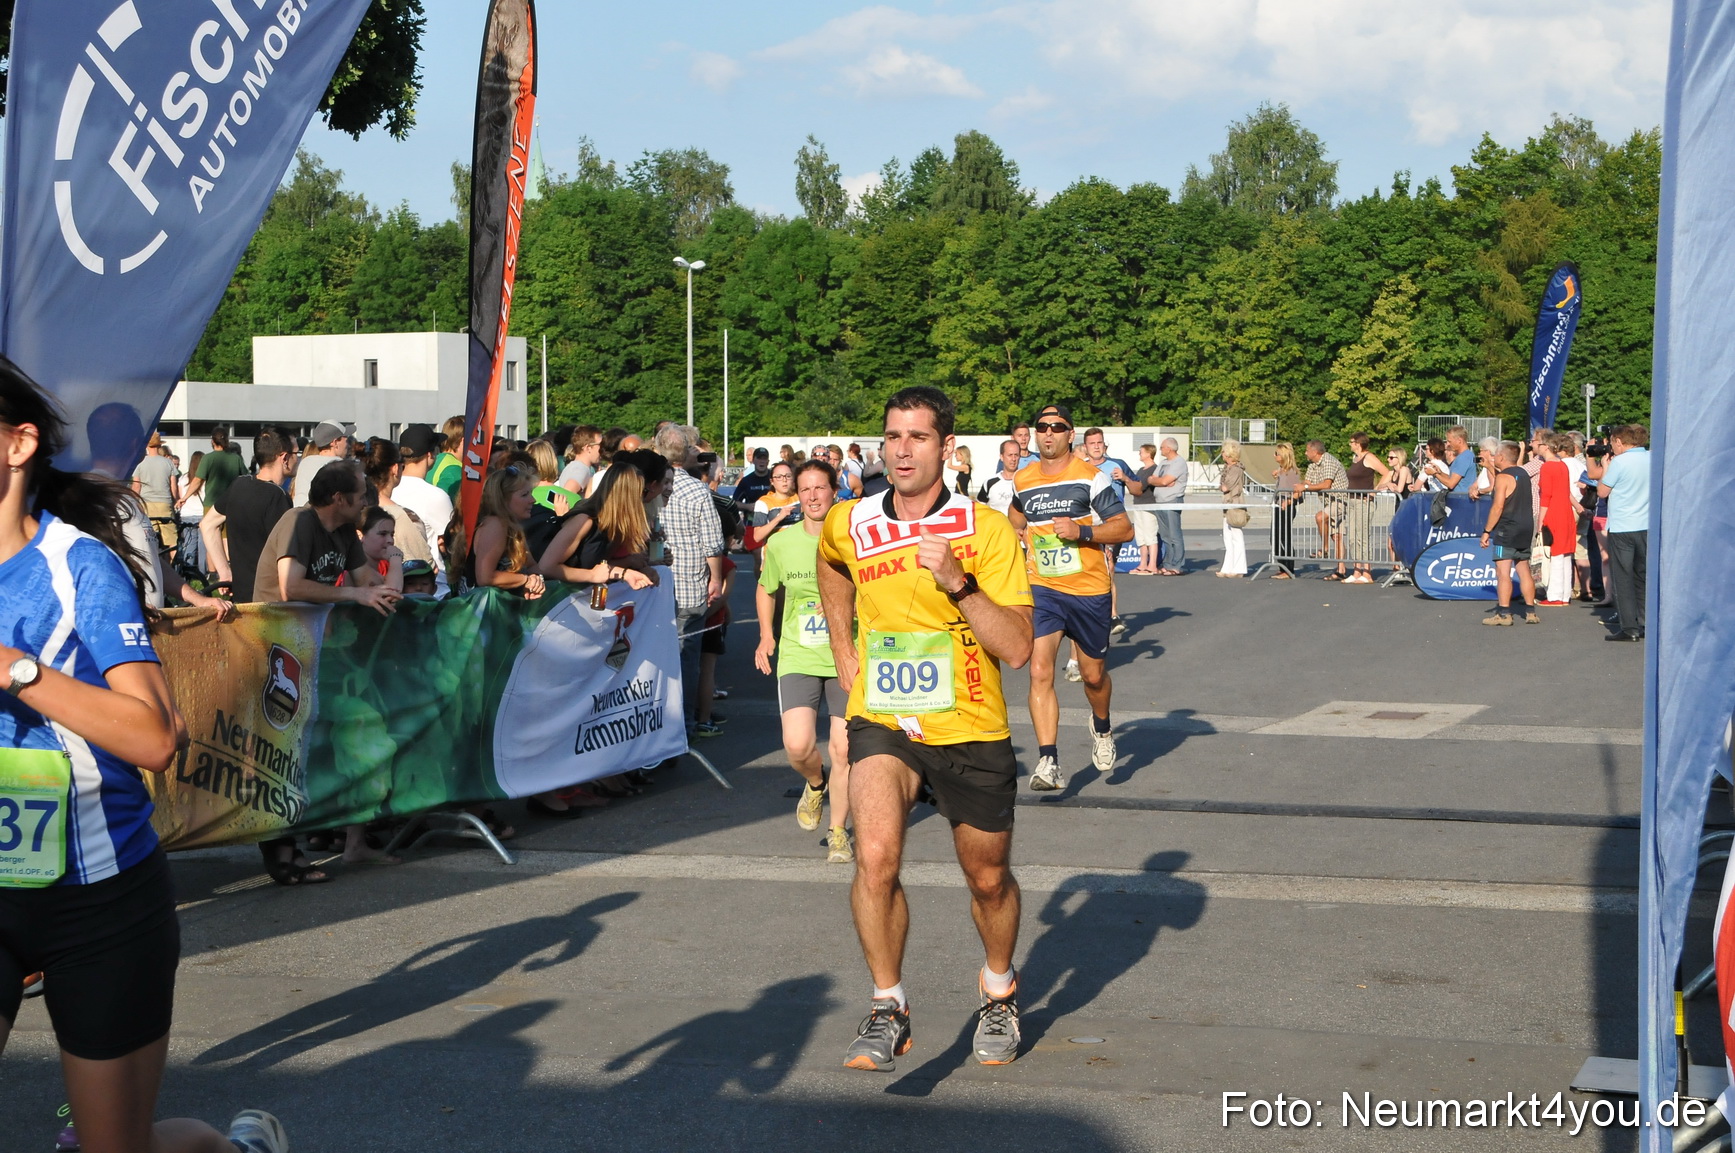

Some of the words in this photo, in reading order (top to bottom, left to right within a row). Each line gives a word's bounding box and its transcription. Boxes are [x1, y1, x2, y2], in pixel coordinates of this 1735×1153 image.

[1032, 498, 1074, 512] Fischer
[1036, 507, 1071, 516] AUTOMOBILE
[858, 556, 908, 584] MAX
[1039, 546, 1072, 567] 375
[1444, 564, 1516, 580] Fischr
[876, 660, 939, 694] 809
[590, 678, 654, 716] Neumarkter
[269, 705, 287, 723] 1628
[575, 700, 664, 756] Lammsbräu
[211, 708, 306, 791] Neumarkte
[0, 797, 59, 852] 37
